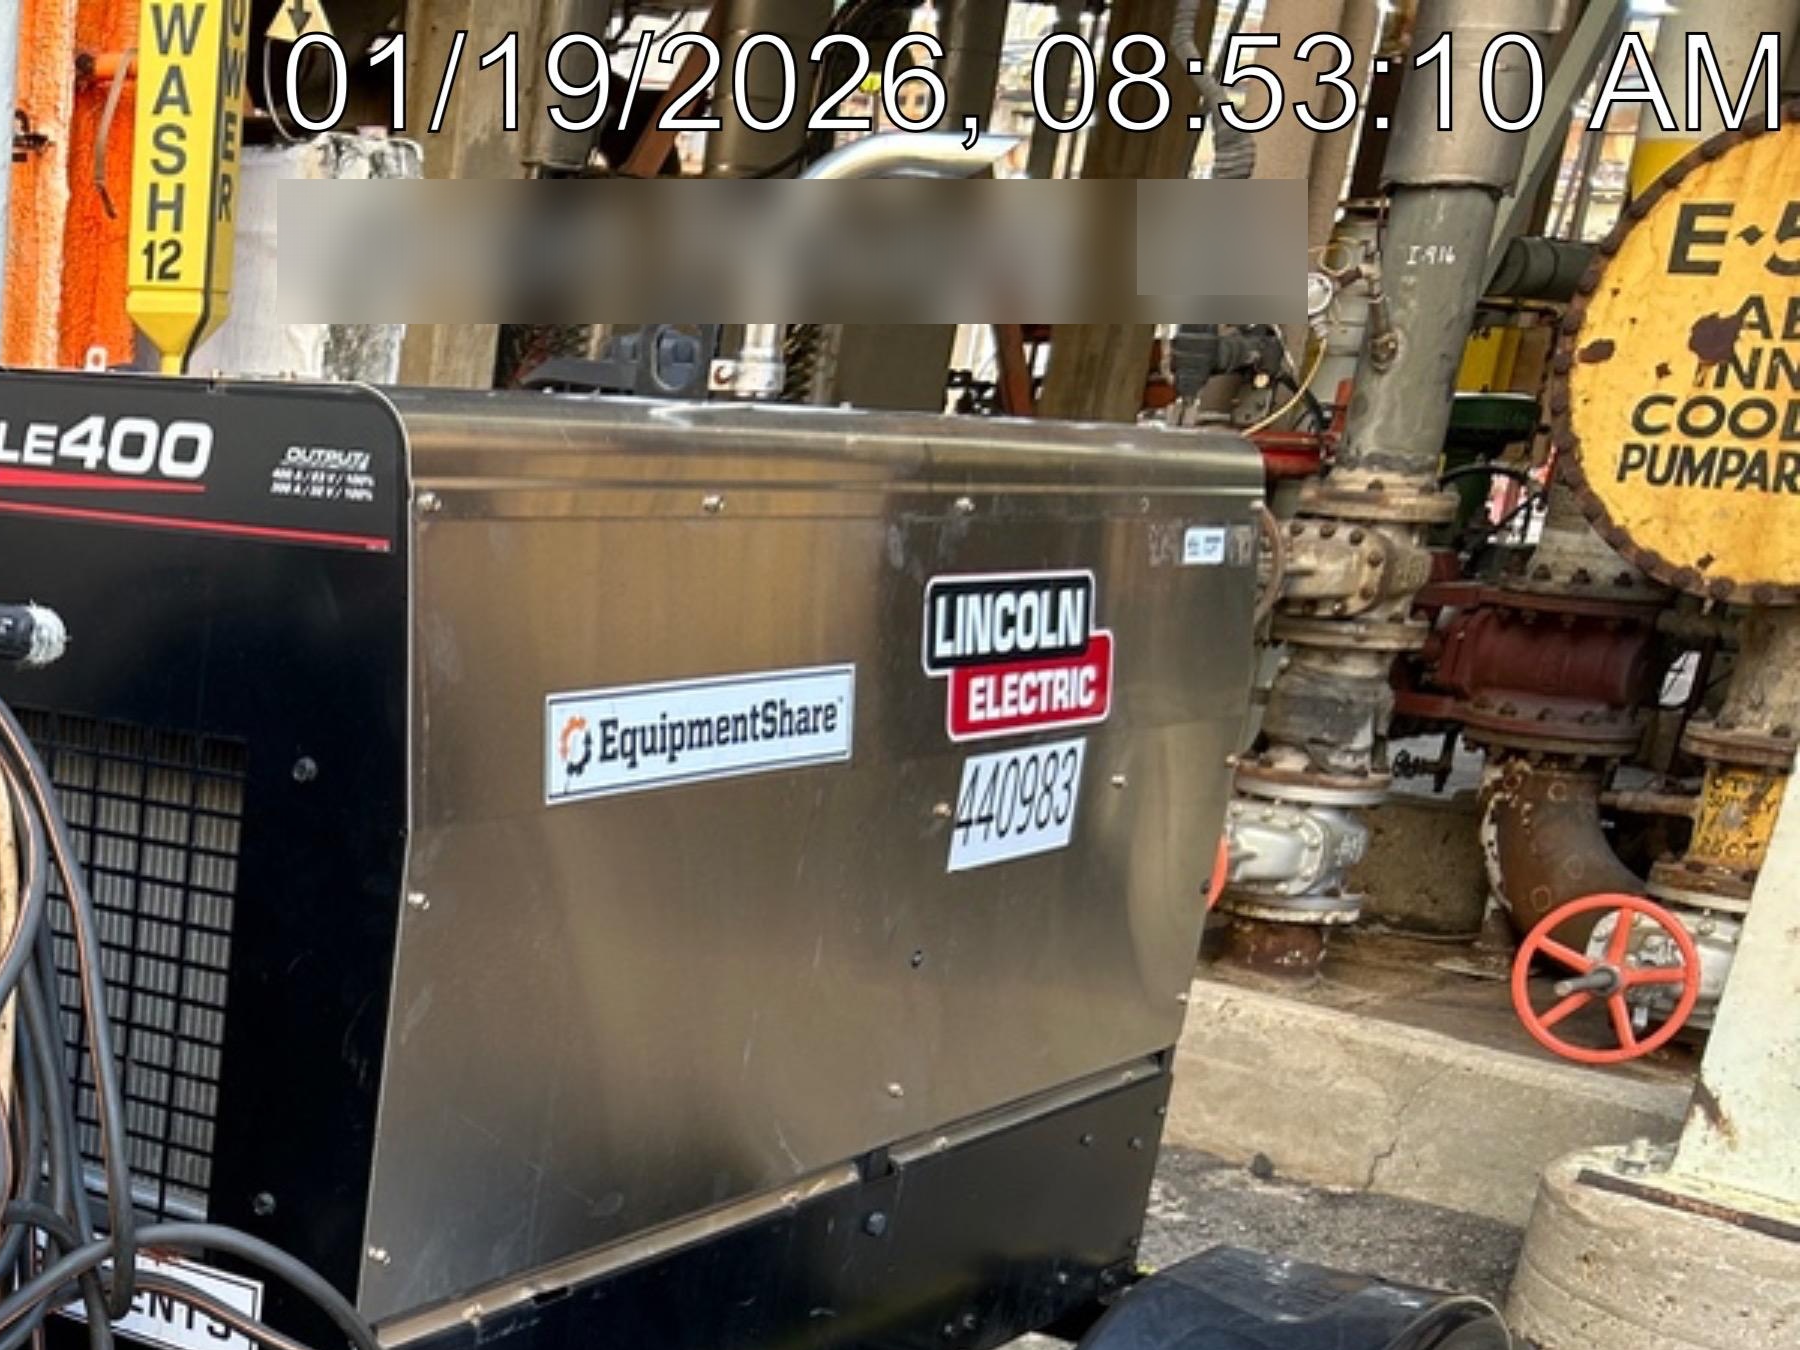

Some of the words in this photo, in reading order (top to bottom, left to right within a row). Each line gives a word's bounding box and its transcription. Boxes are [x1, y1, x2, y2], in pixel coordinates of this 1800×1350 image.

[145, 2, 206, 233] WASH
[141, 239, 184, 282] 12
[934, 588, 1085, 658] LINCOLN
[968, 666, 1097, 723] ELECTRIC
[599, 698, 838, 769] EquipmentShare
[956, 747, 1078, 846] 440983
